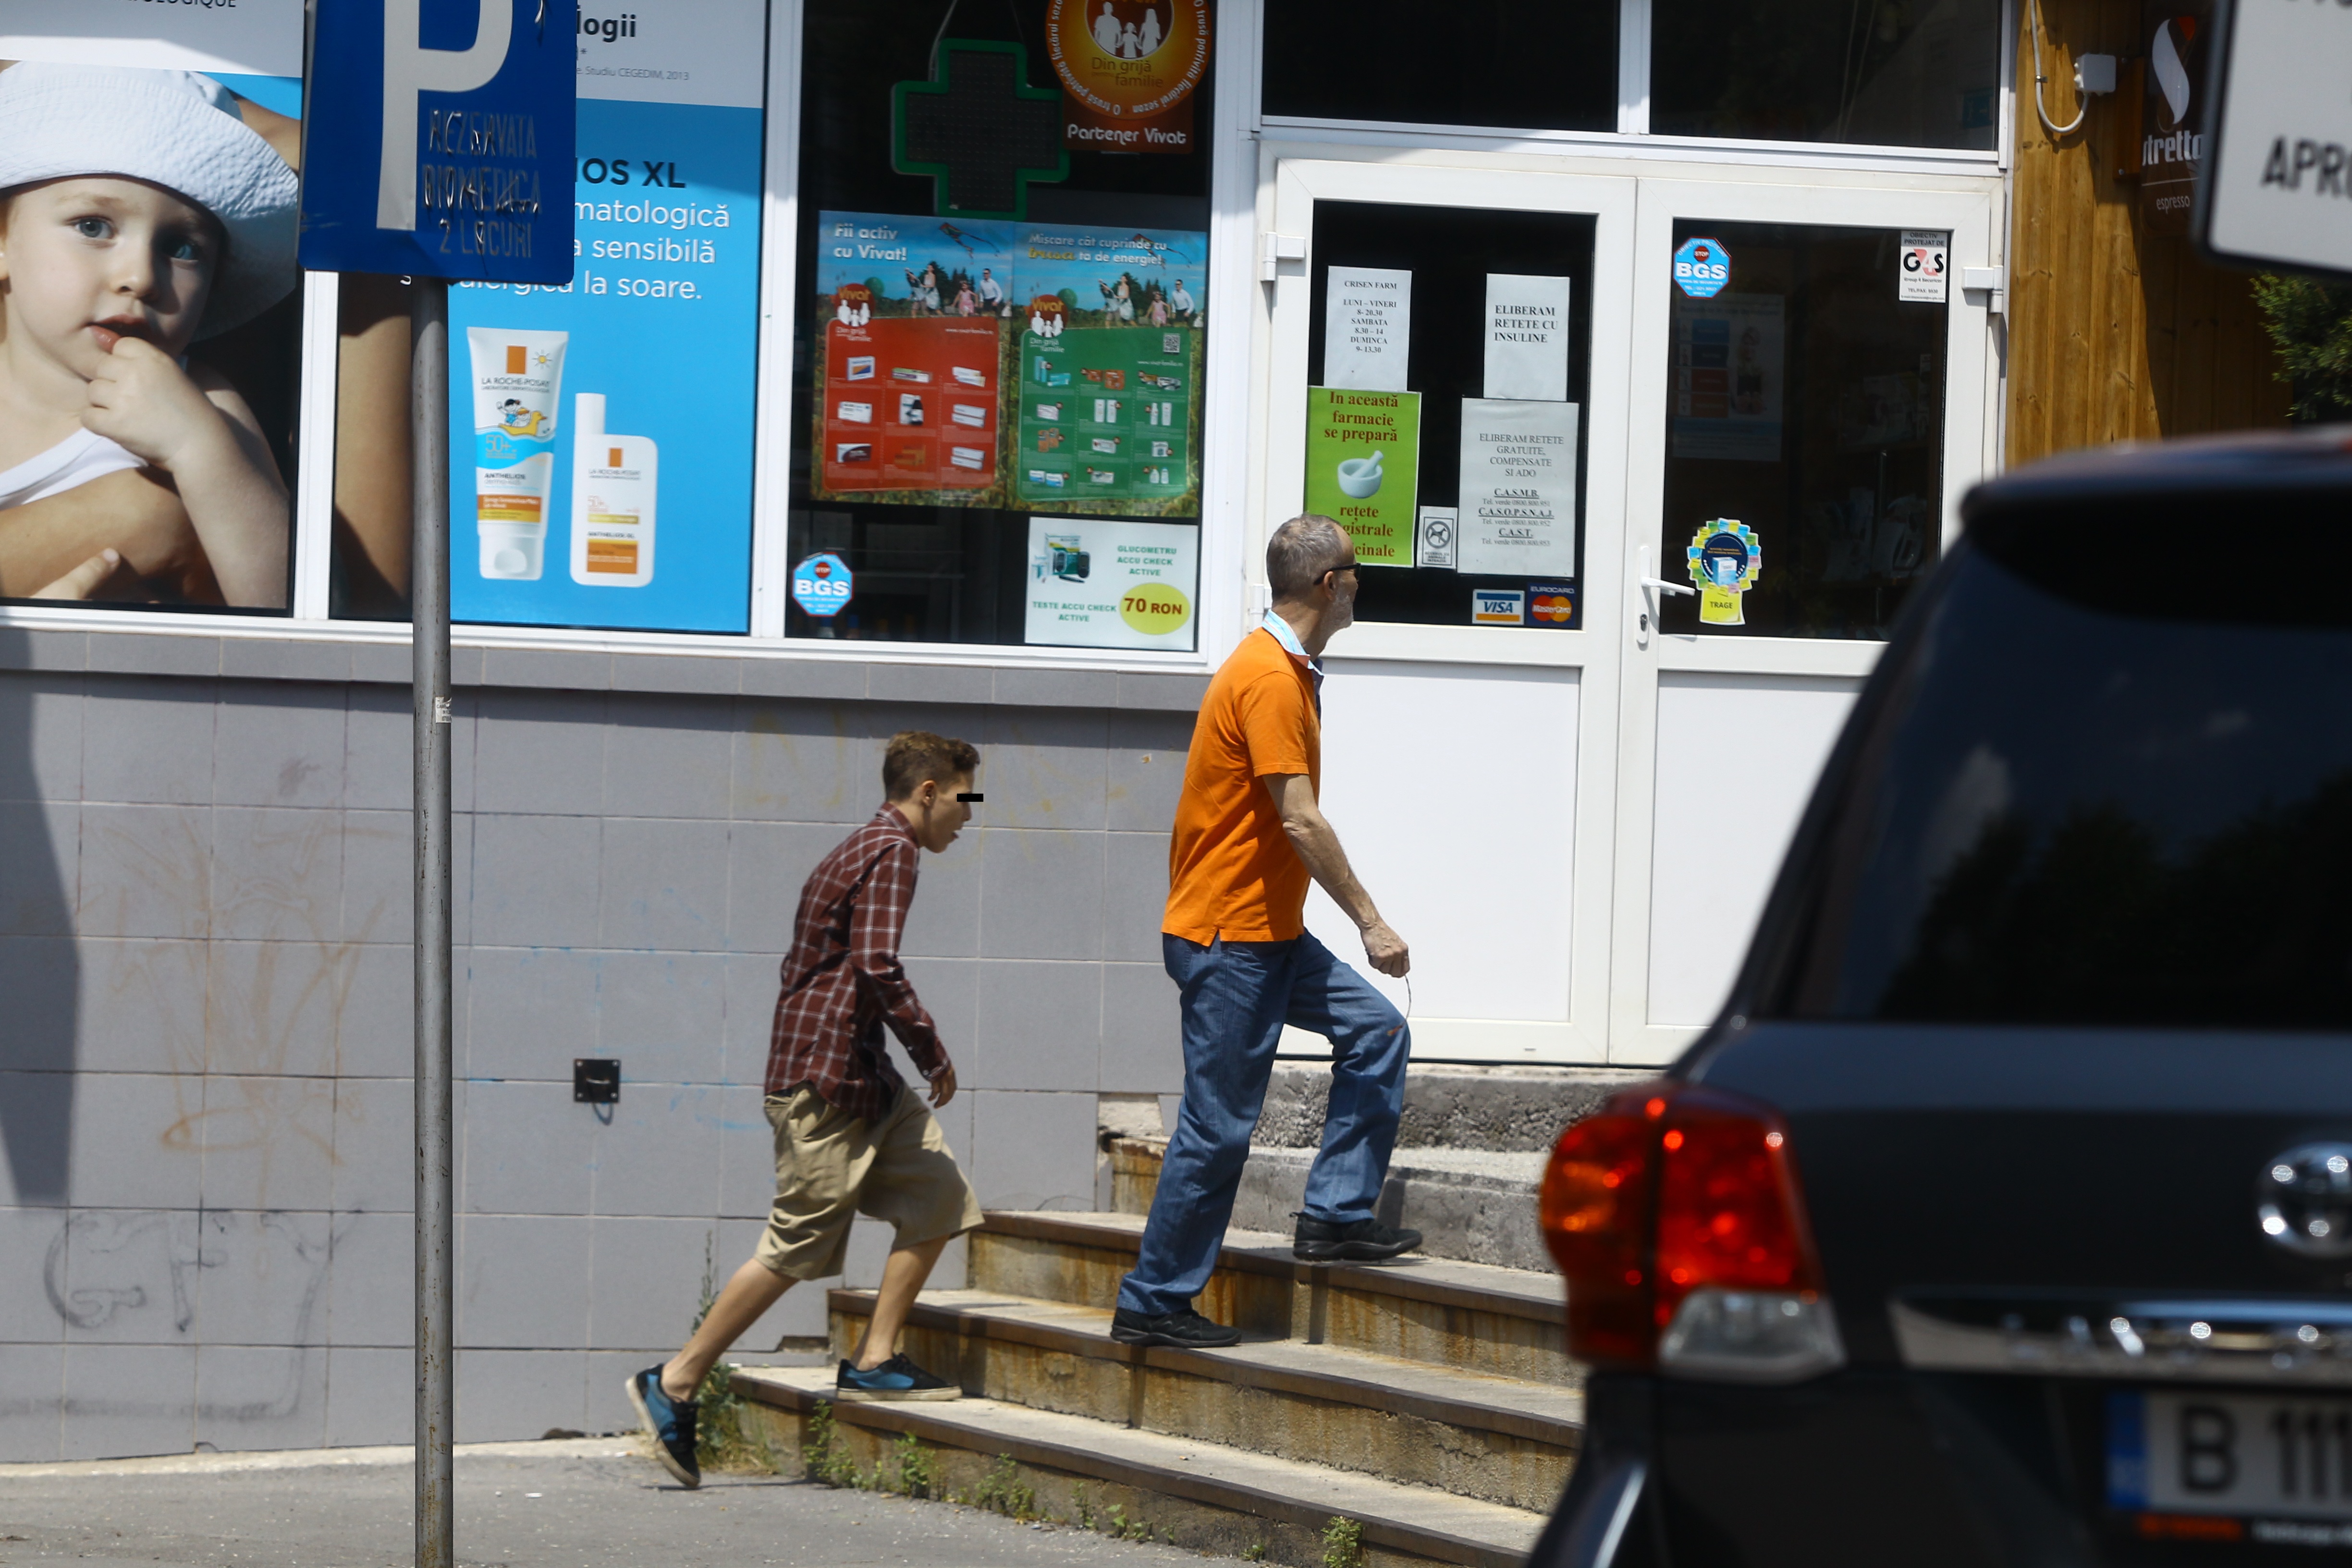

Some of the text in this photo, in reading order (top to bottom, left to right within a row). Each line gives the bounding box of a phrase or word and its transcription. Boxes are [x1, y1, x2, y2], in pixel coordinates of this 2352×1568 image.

[1091, 57, 1115, 72] Din
[585, 66, 615, 76] Studiu
[618, 68, 664, 80] CEGEDIM,
[666, 71, 689, 80] 2013
[1115, 74, 1164, 88] familie
[377, 0, 513, 231] P
[429, 109, 537, 158] REZERVATA
[1067, 124, 1187, 146] Partener Vivat
[642, 161, 686, 188] XL
[2259, 135, 2352, 199] APR
[422, 162, 542, 214] BIOMEDICA
[2156, 196, 2191, 214] espresso
[439, 218, 532, 258] 2 LOCURI
[834, 223, 898, 241] Fii activ
[592, 238, 716, 264] sensibilă
[1078, 236, 1095, 247] cât
[1099, 237, 1152, 252] cuprinde
[1154, 242, 1168, 251] cu
[833, 244, 907, 261] cu Vivat!
[1079, 252, 1091, 262] ta
[1095, 251, 1110, 262] de
[1113, 253, 1163, 268] energie!
[1904, 249, 1944, 275] G4S
[1676, 262, 1727, 279] BGS
[584, 270, 608, 295] la
[617, 278, 703, 300] soare.
[1344, 280, 1373, 288] CRISEN
[1495, 305, 1556, 316] ELIBERAM
[1495, 318, 1558, 330] RETETE CU
[1494, 332, 1548, 343] INSULINE
[1330, 392, 1398, 407] In această
[1333, 410, 1394, 427] farmacie
[485, 434, 511, 453] 50+
[1324, 428, 1398, 443] se prepară
[1480, 433, 1564, 444] ELIBERAM RETETE
[1490, 456, 1552, 466] COMPENSATE
[1505, 468, 1536, 478] SI ADO
[1117, 545, 1177, 555] GLUCOMETRU
[1353, 544, 1395, 557] cinale
[796, 579, 850, 596] BGS
[1530, 586, 1575, 594] EUROCARD
[1033, 601, 1116, 612] TESTE ACCU CHECK
[1124, 598, 1182, 615] 70 RON
[1483, 601, 1513, 613] VISA
[1531, 604, 1572, 614] MasterCard
[1058, 614, 1090, 622] ACTIVE
[2179, 1407, 2236, 1493] B
